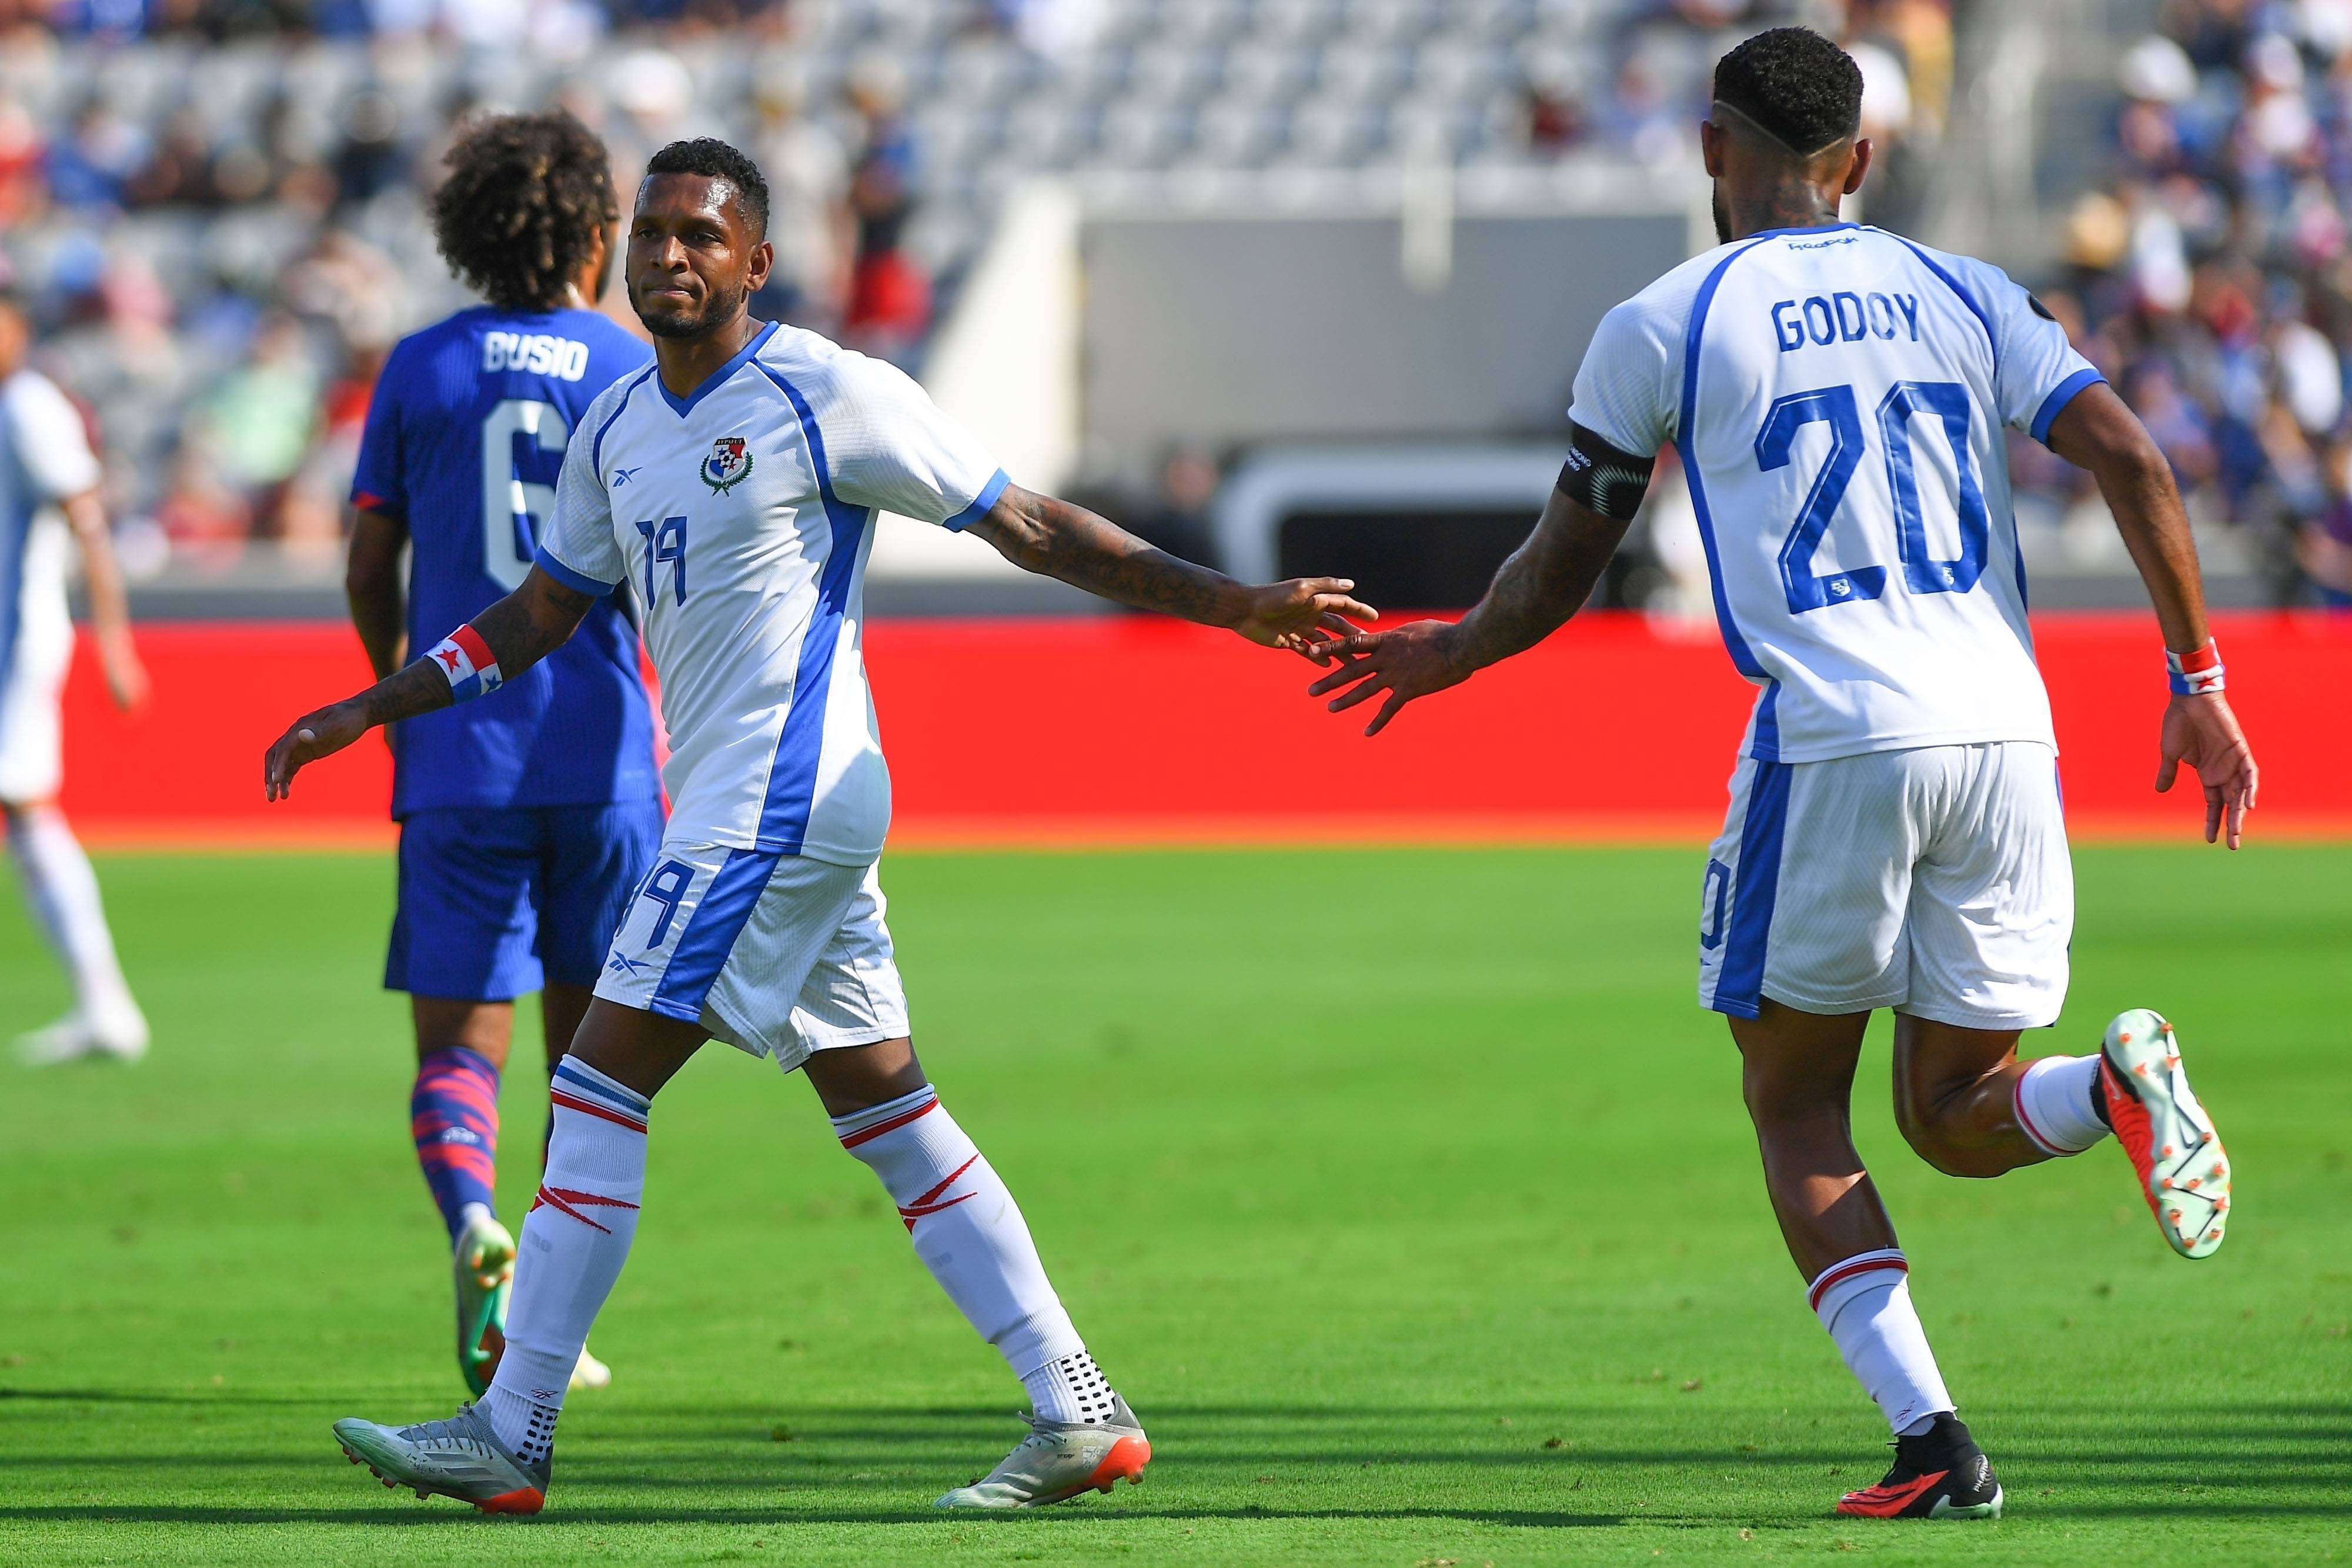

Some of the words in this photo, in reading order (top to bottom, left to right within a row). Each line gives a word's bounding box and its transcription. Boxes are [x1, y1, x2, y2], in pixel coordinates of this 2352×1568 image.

[483, 331, 590, 382] BUSIO
[1771, 291, 1919, 352] GODOY
[482, 399, 569, 593] 6
[1754, 380, 1988, 615] 20
[636, 516, 687, 610] 19
[616, 859, 696, 950] 9
